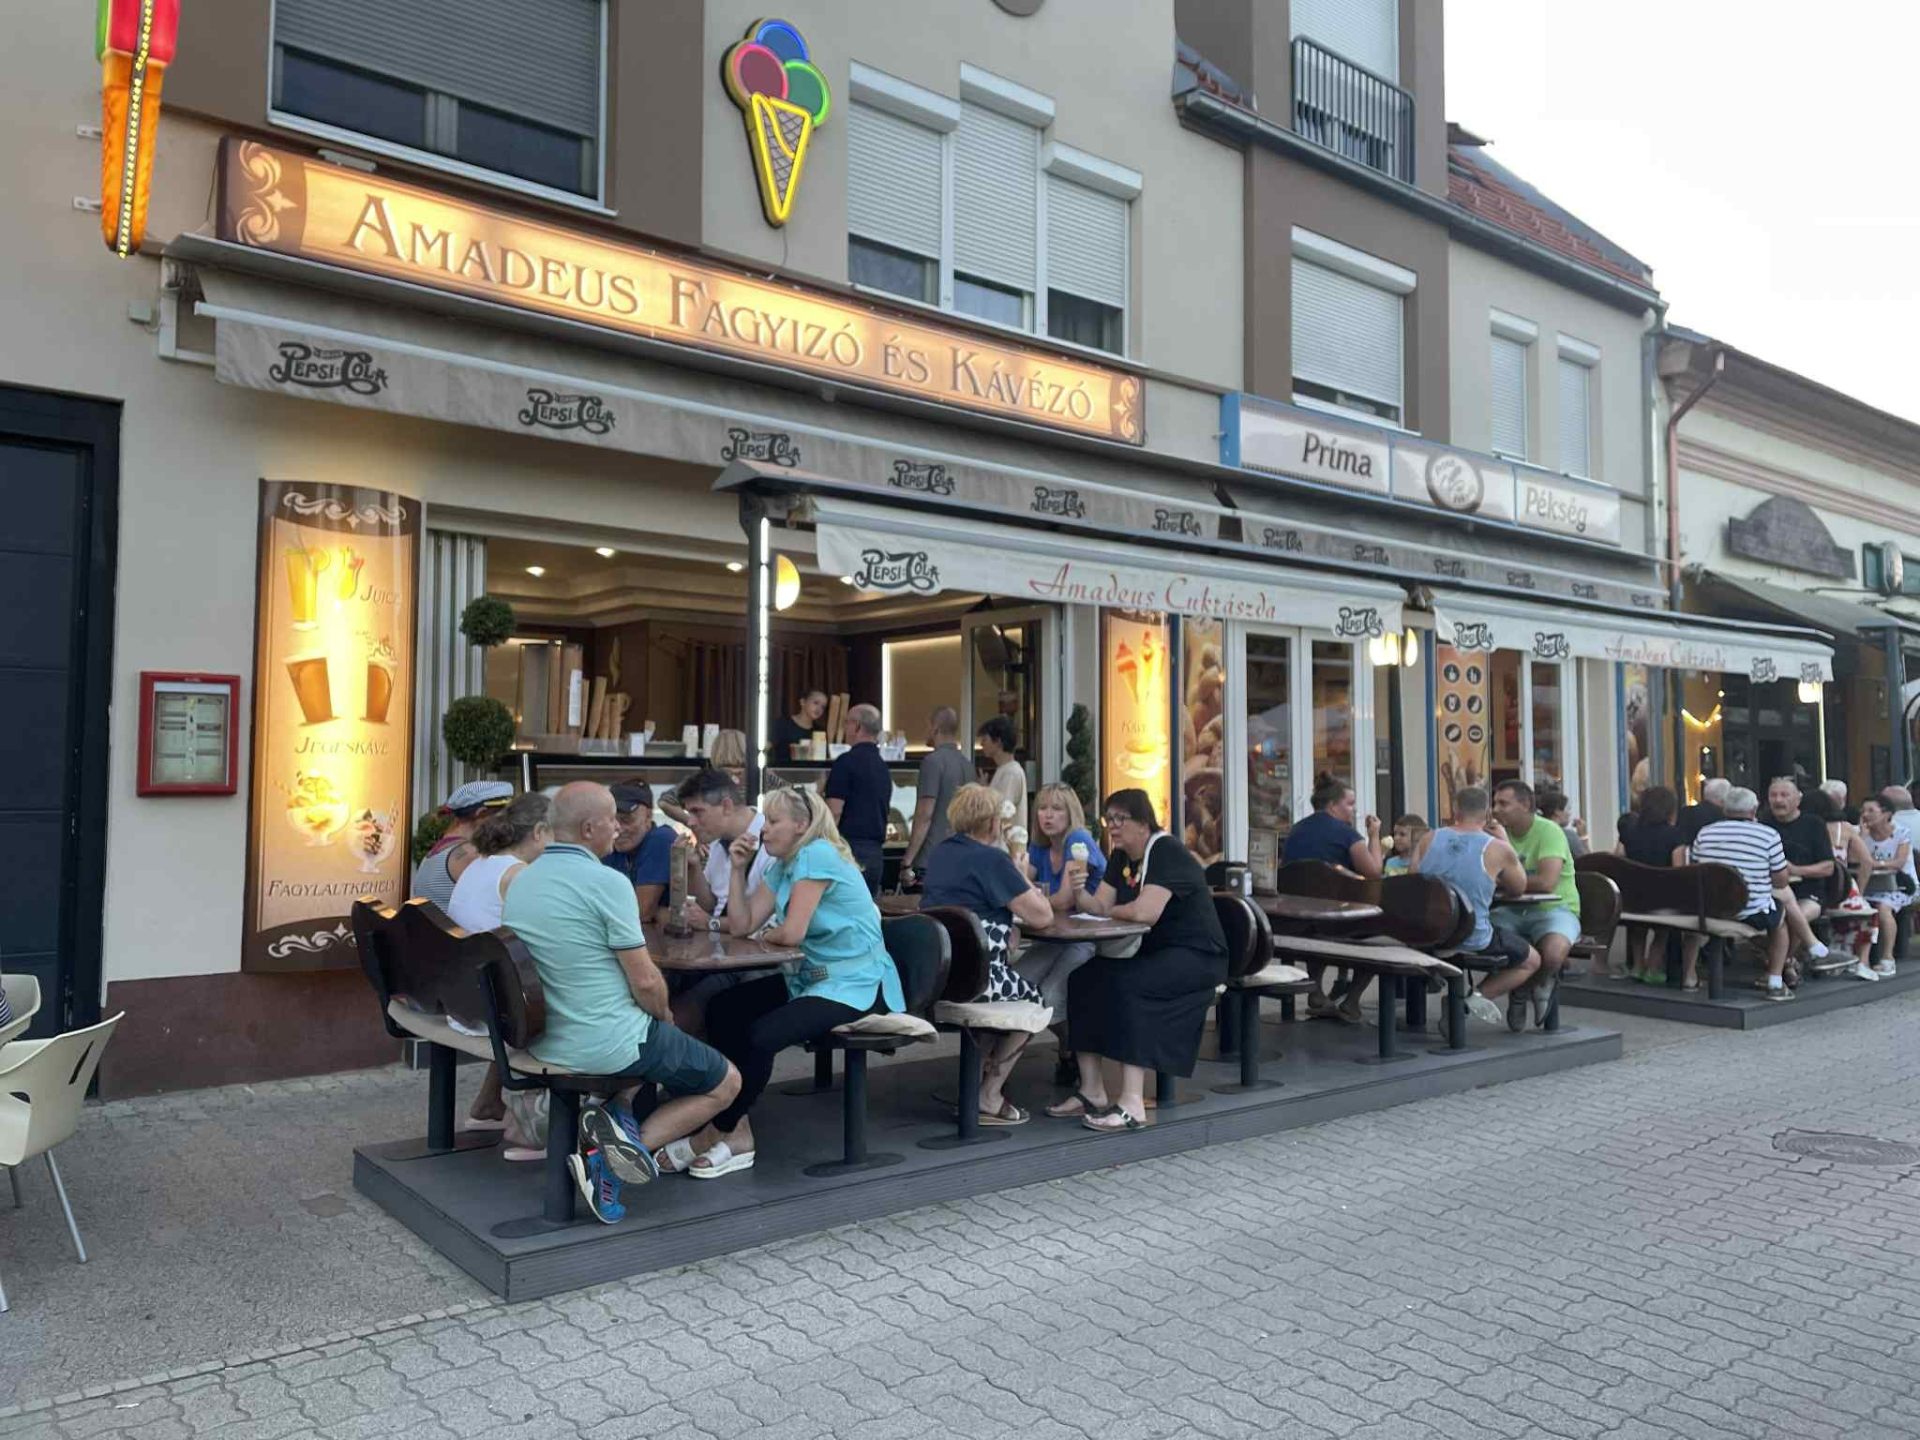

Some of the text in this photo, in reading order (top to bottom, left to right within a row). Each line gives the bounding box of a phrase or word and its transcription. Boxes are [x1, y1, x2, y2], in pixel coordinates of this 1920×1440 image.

[342, 193, 1092, 420] AMADEUS FAGYIZÓ ÉS KÁVÉZÓ
[1525, 486, 1588, 533] Pékség
[1028, 562, 1277, 620] Amadeus Cukrászda
